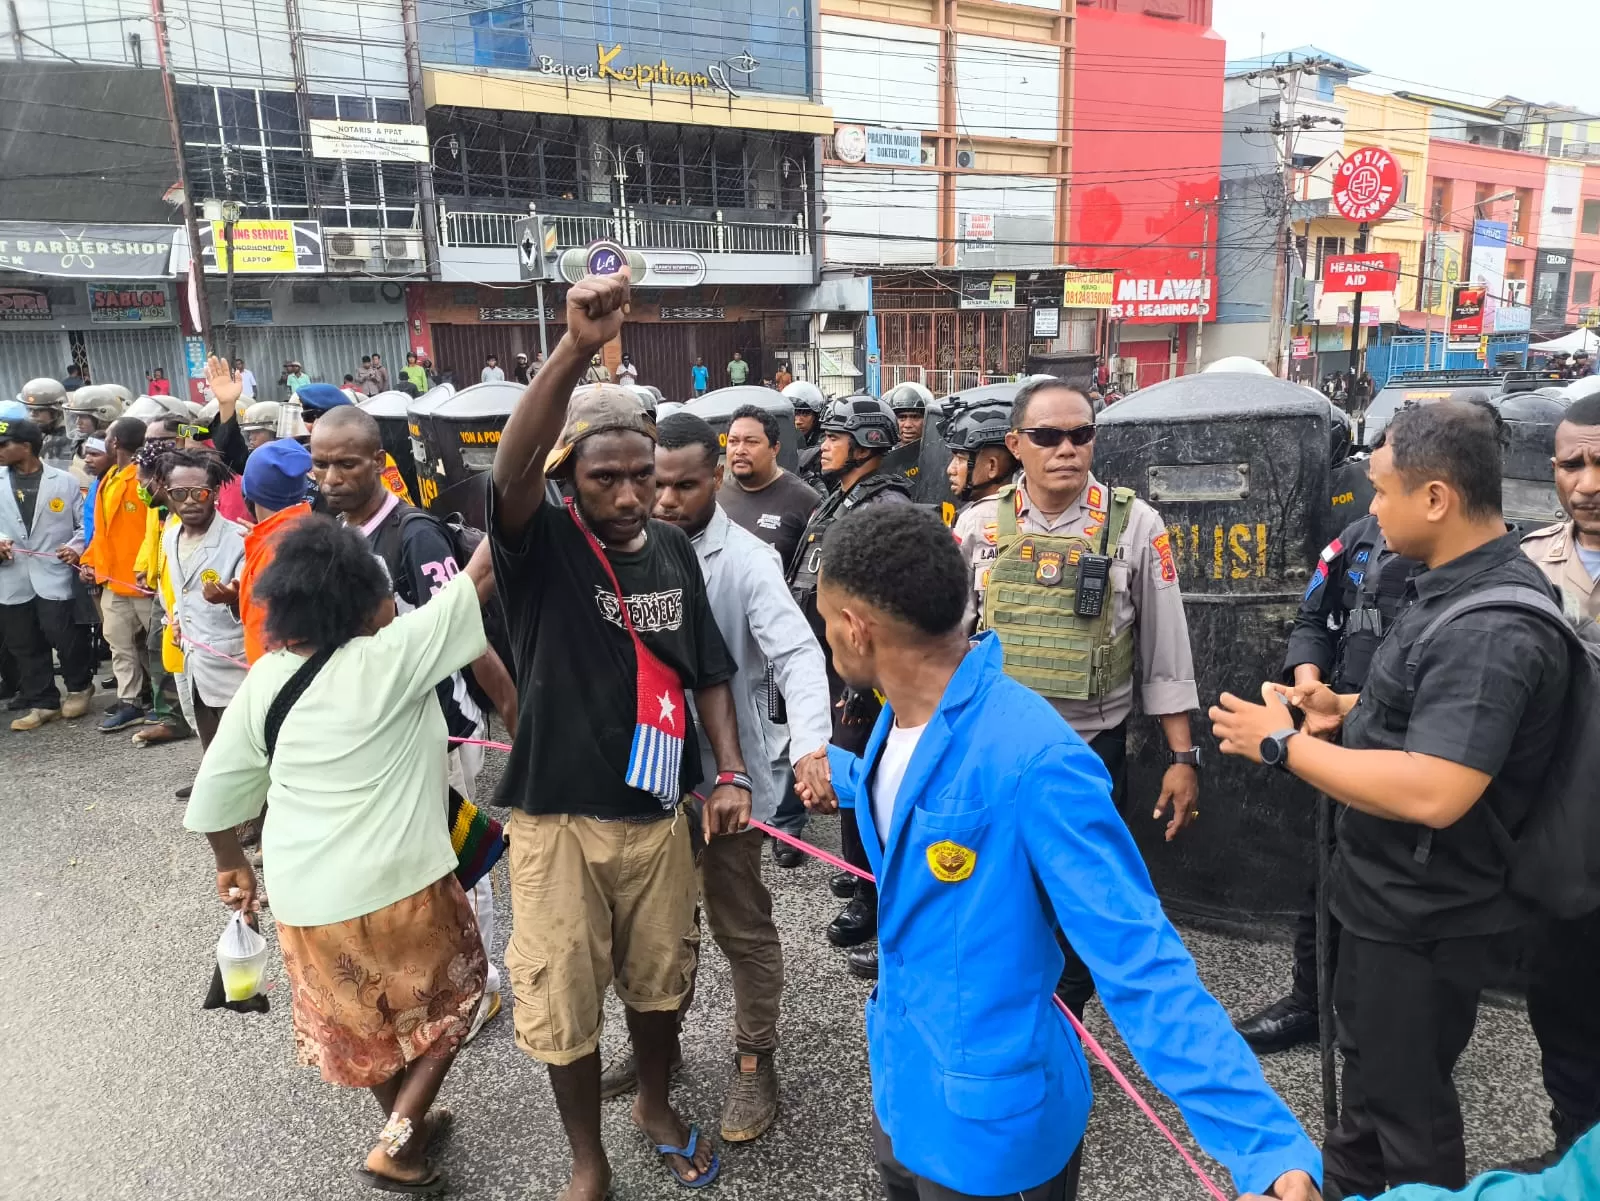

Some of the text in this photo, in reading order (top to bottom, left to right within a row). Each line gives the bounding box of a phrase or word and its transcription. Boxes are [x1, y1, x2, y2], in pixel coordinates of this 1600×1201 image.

[538, 43, 709, 89] Bangi Kopitiam
[338, 126, 372, 134] NOTARIS
[867, 132, 919, 147] PRAKTIK MANDIRI
[876, 147, 898, 159] DOKTER
[898, 149, 910, 160] GIGI
[1342, 150, 1391, 176] OPTIK
[1336, 185, 1393, 219] MELAWAI
[252, 229, 289, 240] SERVICE
[16, 240, 170, 255] BARBERSHOP
[1330, 260, 1385, 274] HEARING
[1344, 274, 1367, 287] AID
[1117, 278, 1211, 301] MELAWAI
[1138, 303, 1189, 317] HEARING
[460, 431, 502, 443] YON A POR
[1331, 492, 1355, 506] POR
